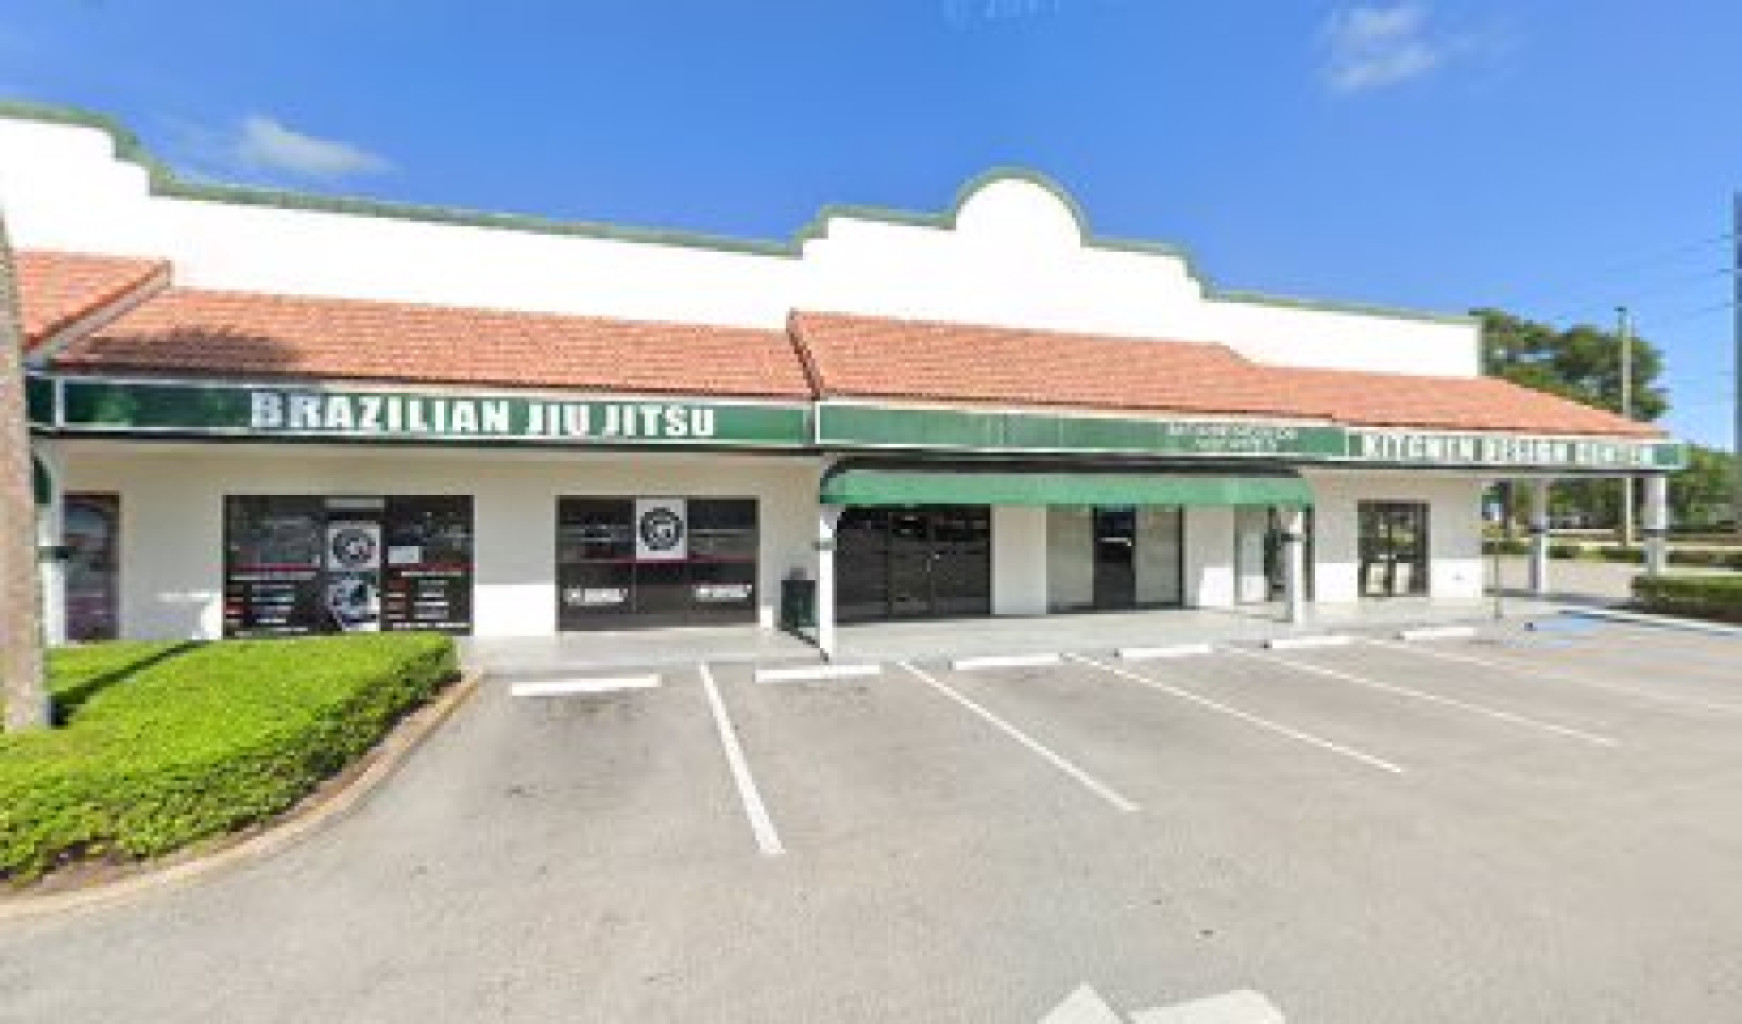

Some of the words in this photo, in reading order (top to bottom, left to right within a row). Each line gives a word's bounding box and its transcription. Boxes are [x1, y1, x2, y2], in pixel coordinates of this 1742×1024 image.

[251, 392, 509, 432] BRAZILIAN
[525, 402, 590, 436] JIU
[602, 404, 715, 436] JITSU
[1363, 433, 1473, 461] KITCHEN
